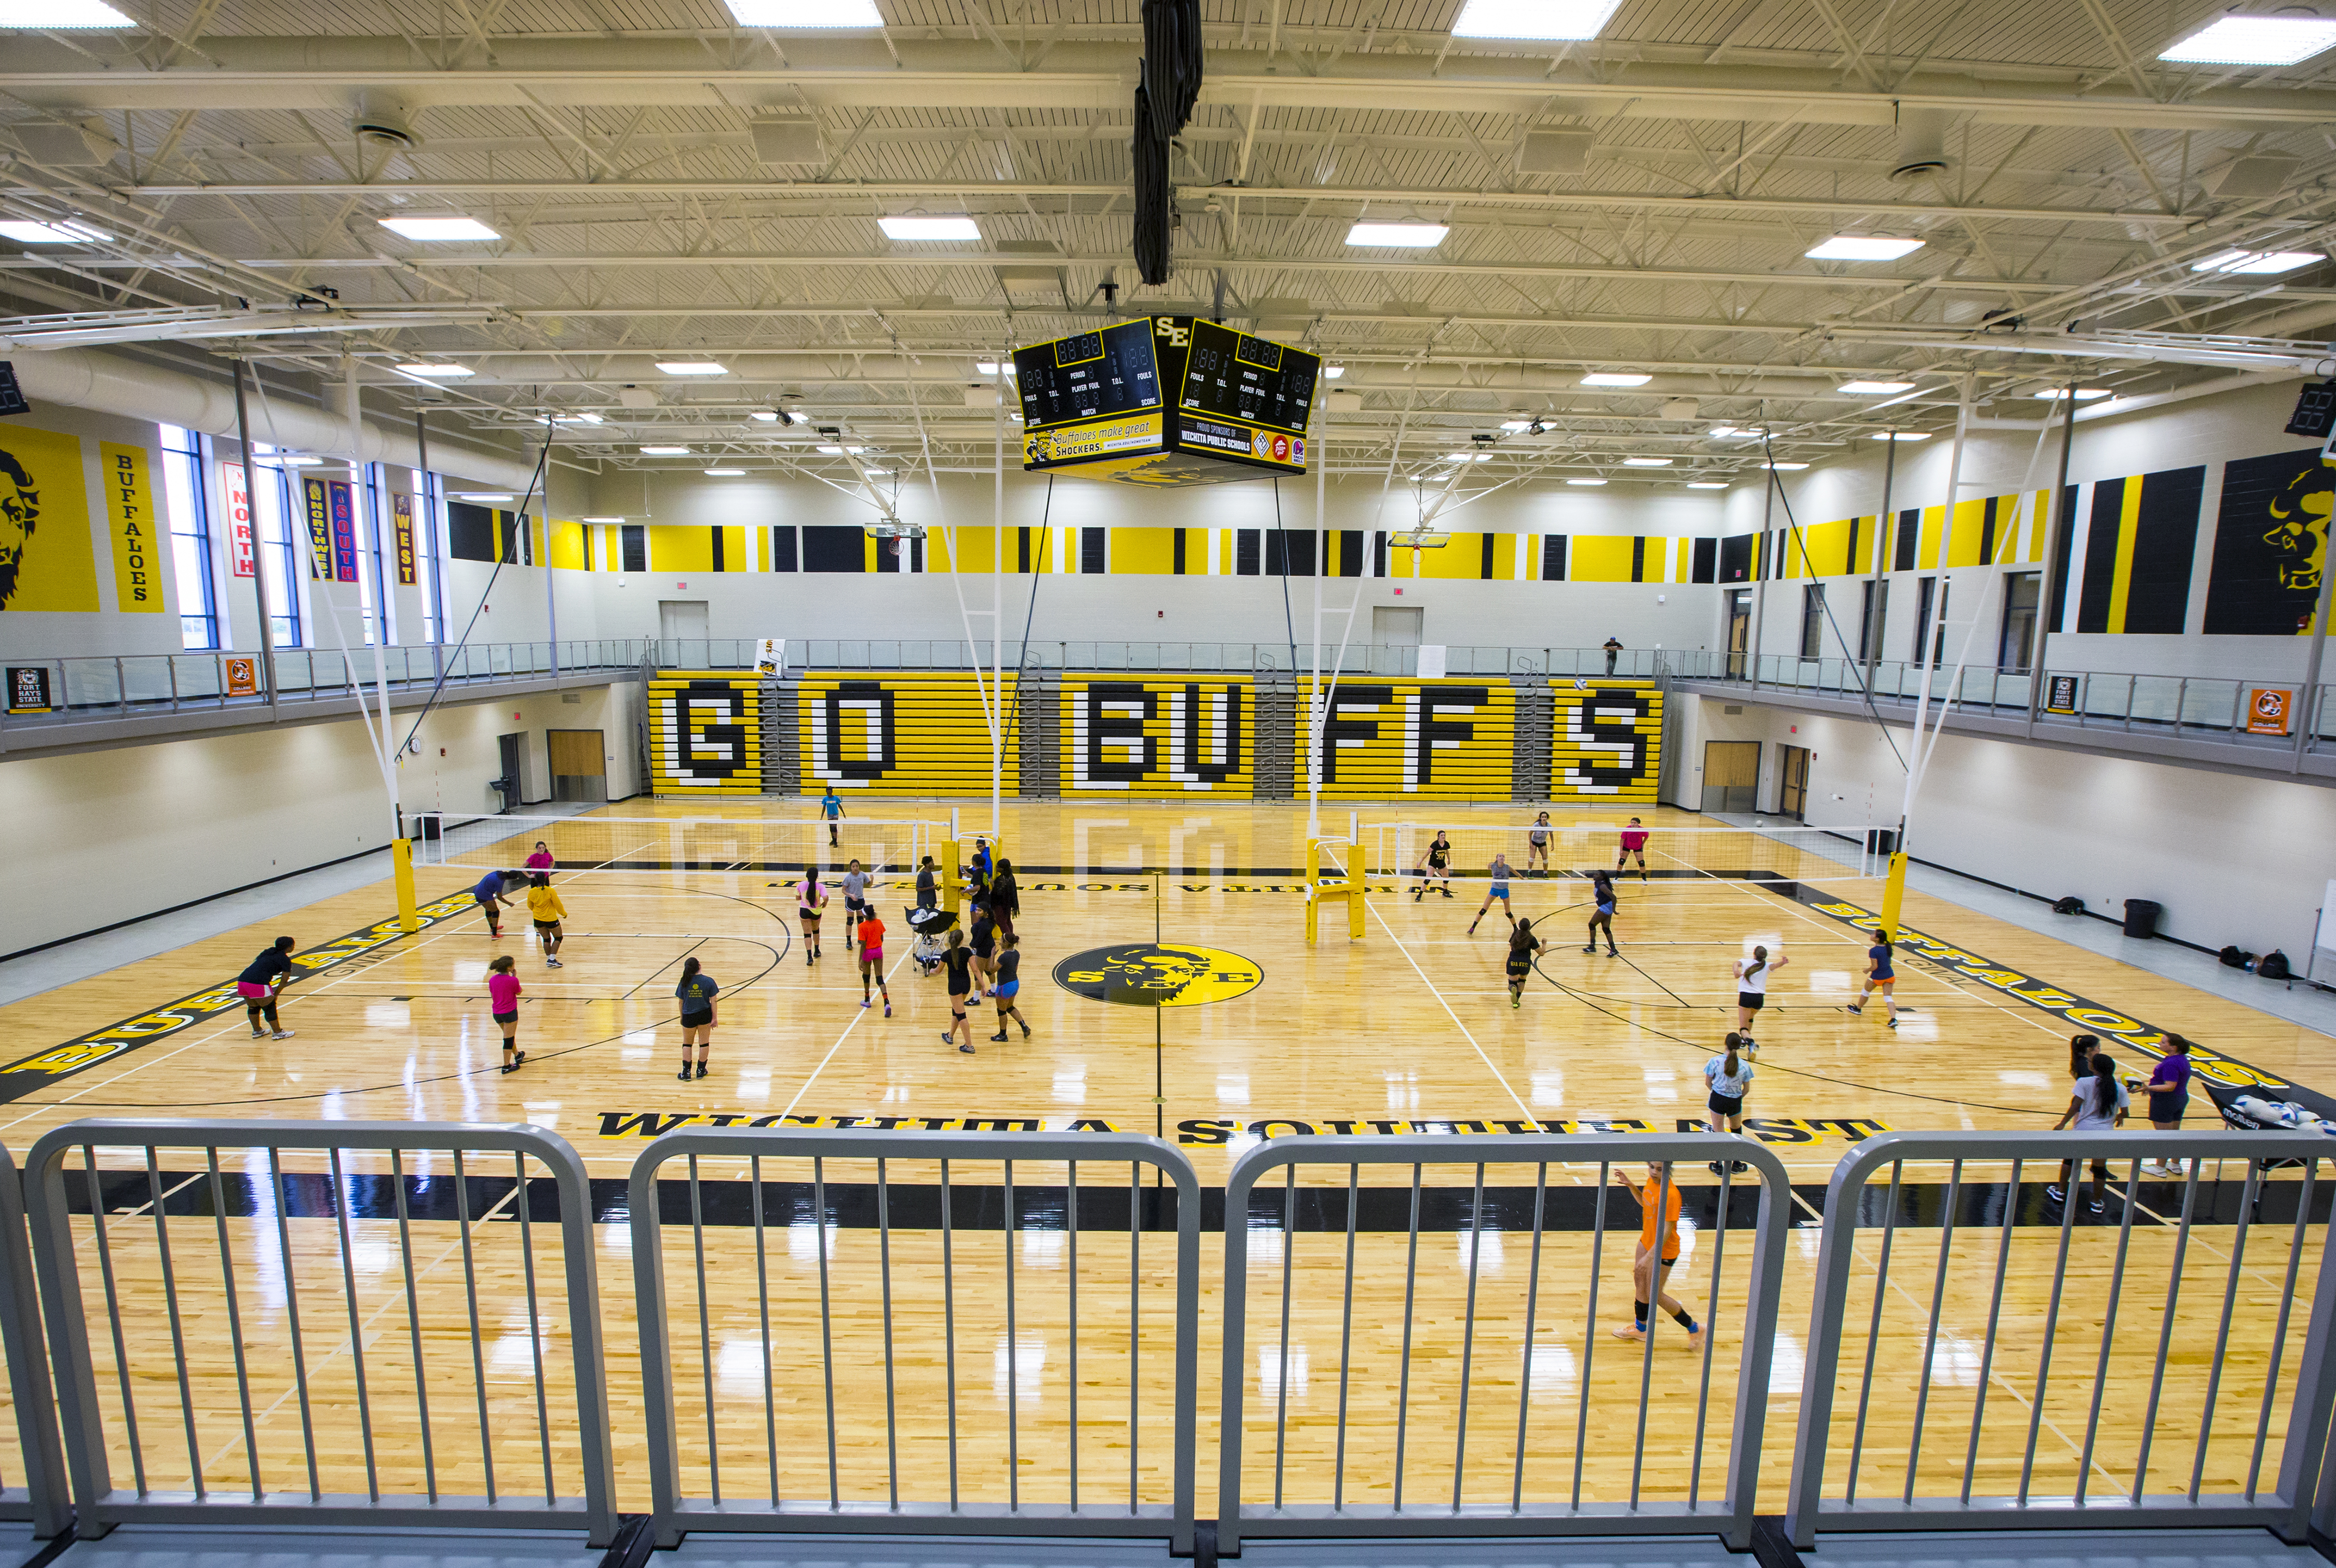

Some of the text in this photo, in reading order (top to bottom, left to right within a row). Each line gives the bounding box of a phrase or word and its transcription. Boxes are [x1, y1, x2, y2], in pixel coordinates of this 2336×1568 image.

[1156, 317, 1189, 347] SE
[1070, 371, 1085, 379] PERIOD
[1137, 371, 1152, 380] FOULS
[1190, 372, 1204, 381] FOULS
[1243, 371, 1257, 380] PERIOD
[1217, 379, 1227, 387] T.O.L.
[1072, 384, 1087, 393] PLAYER
[1240, 385, 1265, 397] PLAYER FOUL
[1025, 394, 1037, 402] FOULS
[1141, 398, 1156, 406] SCORE
[1276, 393, 1285, 402] T.O.L.
[1185, 398, 1200, 407] SCORE
[1296, 399, 1308, 407] FOULS
[1081, 408, 1096, 416] MATCH
[1241, 411, 1254, 419] MATCH
[1028, 417, 1041, 426] SCORE
[1291, 421, 1303, 430] SCORE
[1056, 421, 1150, 446] Buffaloes make great
[1197, 422, 1236, 438] PROUD SPONSORS OF
[1181, 430, 1206, 443] WICHITA
[1207, 435, 1227, 447] PUBLIC
[1227, 439, 1250, 452] SCHOOLS
[116, 454, 147, 602] BUFFALOES
[233, 490, 254, 573] NORTH
[310, 501, 329, 579] NORTHWEST
[336, 505, 354, 580] SOUTH
[396, 513, 412, 582] WEST
[662, 681, 1650, 794] GO BUFFS
[323, 947, 408, 978] GWAL
[1903, 958, 1977, 990] GWAL
[2223, 1107, 2261, 1130] molten
